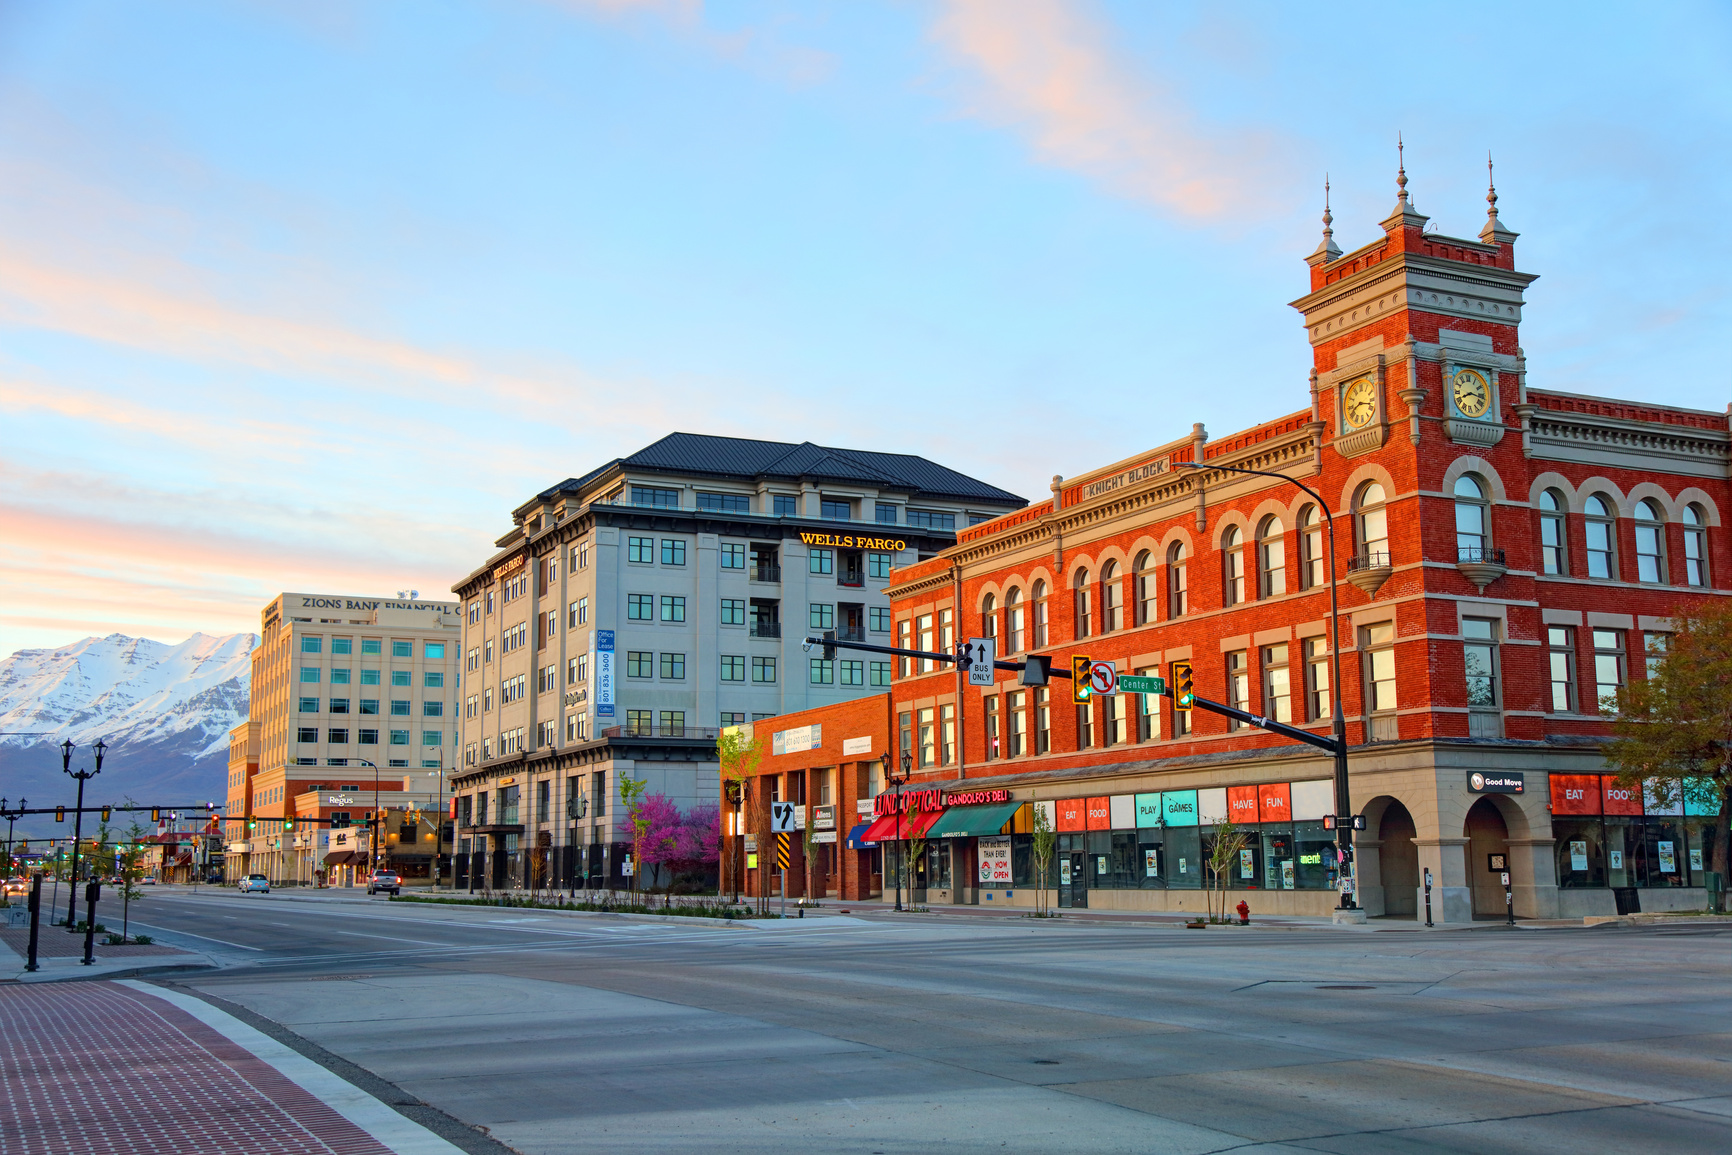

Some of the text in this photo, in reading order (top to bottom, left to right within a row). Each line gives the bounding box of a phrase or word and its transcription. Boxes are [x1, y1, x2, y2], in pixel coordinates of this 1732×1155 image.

[1088, 460, 1165, 497] KNIGHT BLOCK
[800, 532, 906, 551] WELLS FARGO
[302, 597, 342, 609] ZIONS
[346, 600, 380, 611] BANK
[602, 653, 610, 672] 3600
[974, 664, 989, 672] BUS
[602, 674, 610, 688] 836
[972, 673, 991, 681] ONLY
[1123, 679, 1162, 690] Center St
[602, 690, 610, 703] 801
[1485, 778, 1522, 786] Good Move
[948, 789, 1008, 806] GANDOLFO'S DELI
[1565, 789, 1584, 800] EAT
[329, 796, 354, 806] Regus
[874, 788, 943, 816] LUND OPTICAL
[1232, 799, 1254, 810] HAVE
[1266, 797, 1283, 808] FUN
[1089, 809, 1107, 818] FOOD
[1140, 805, 1157, 815] PLAY
[1168, 803, 1193, 814] GAMES
[1065, 810, 1077, 820] EAT
[983, 850, 1007, 858] THAN EVER!
[994, 860, 1008, 868] NOW
[993, 870, 1009, 879] OPEN
